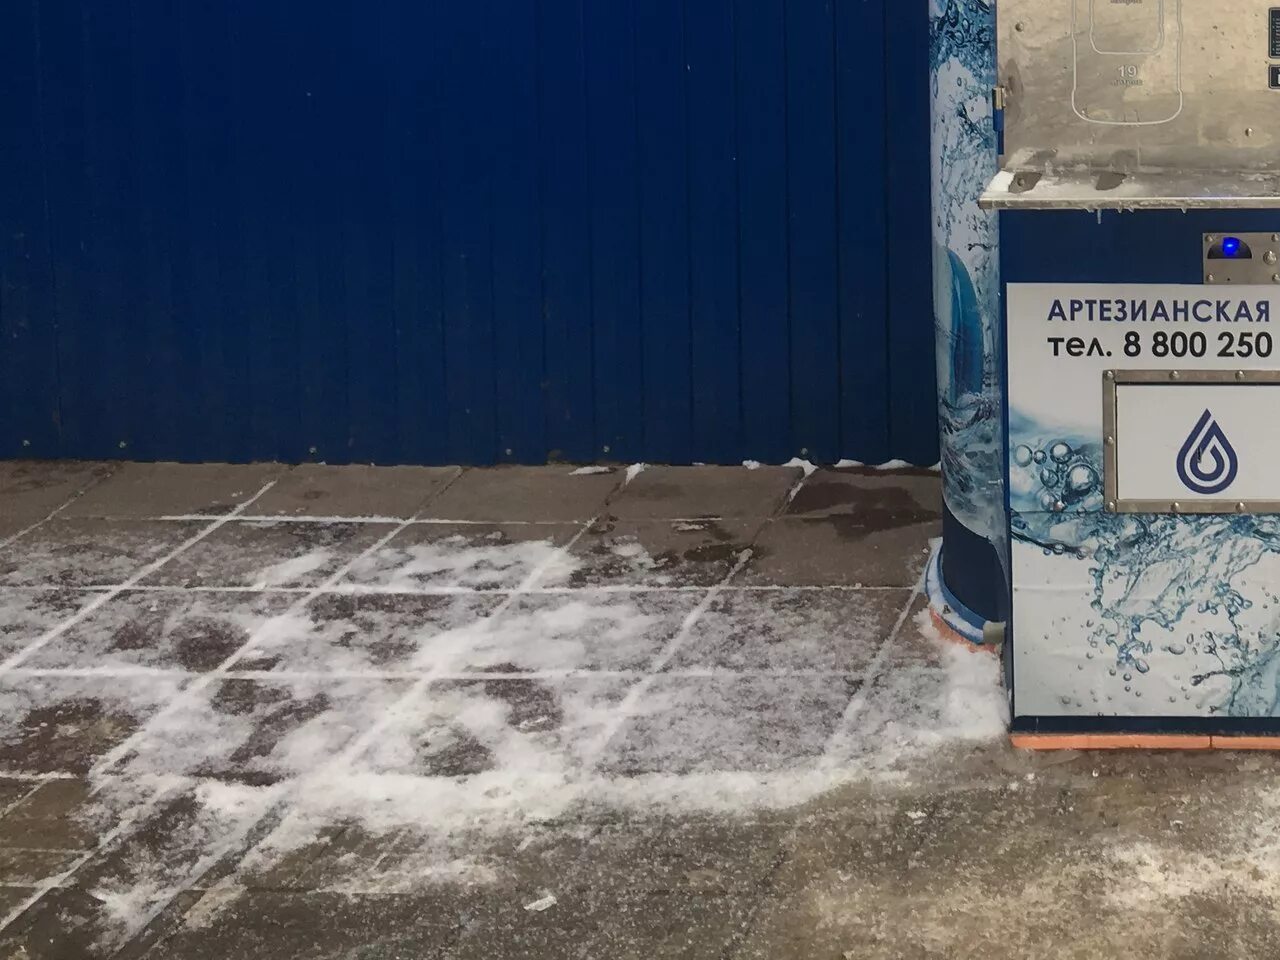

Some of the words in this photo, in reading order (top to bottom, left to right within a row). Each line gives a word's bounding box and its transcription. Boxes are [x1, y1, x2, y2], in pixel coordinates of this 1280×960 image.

[1118, 65, 1138, 77] 19
[1047, 299, 1270, 323] АРТЕЗИАНСКАЯ
[1047, 336, 1113, 358] тел.
[1123, 331, 1142, 358] 8
[1151, 331, 1207, 358] 800
[1216, 331, 1273, 358] 250
